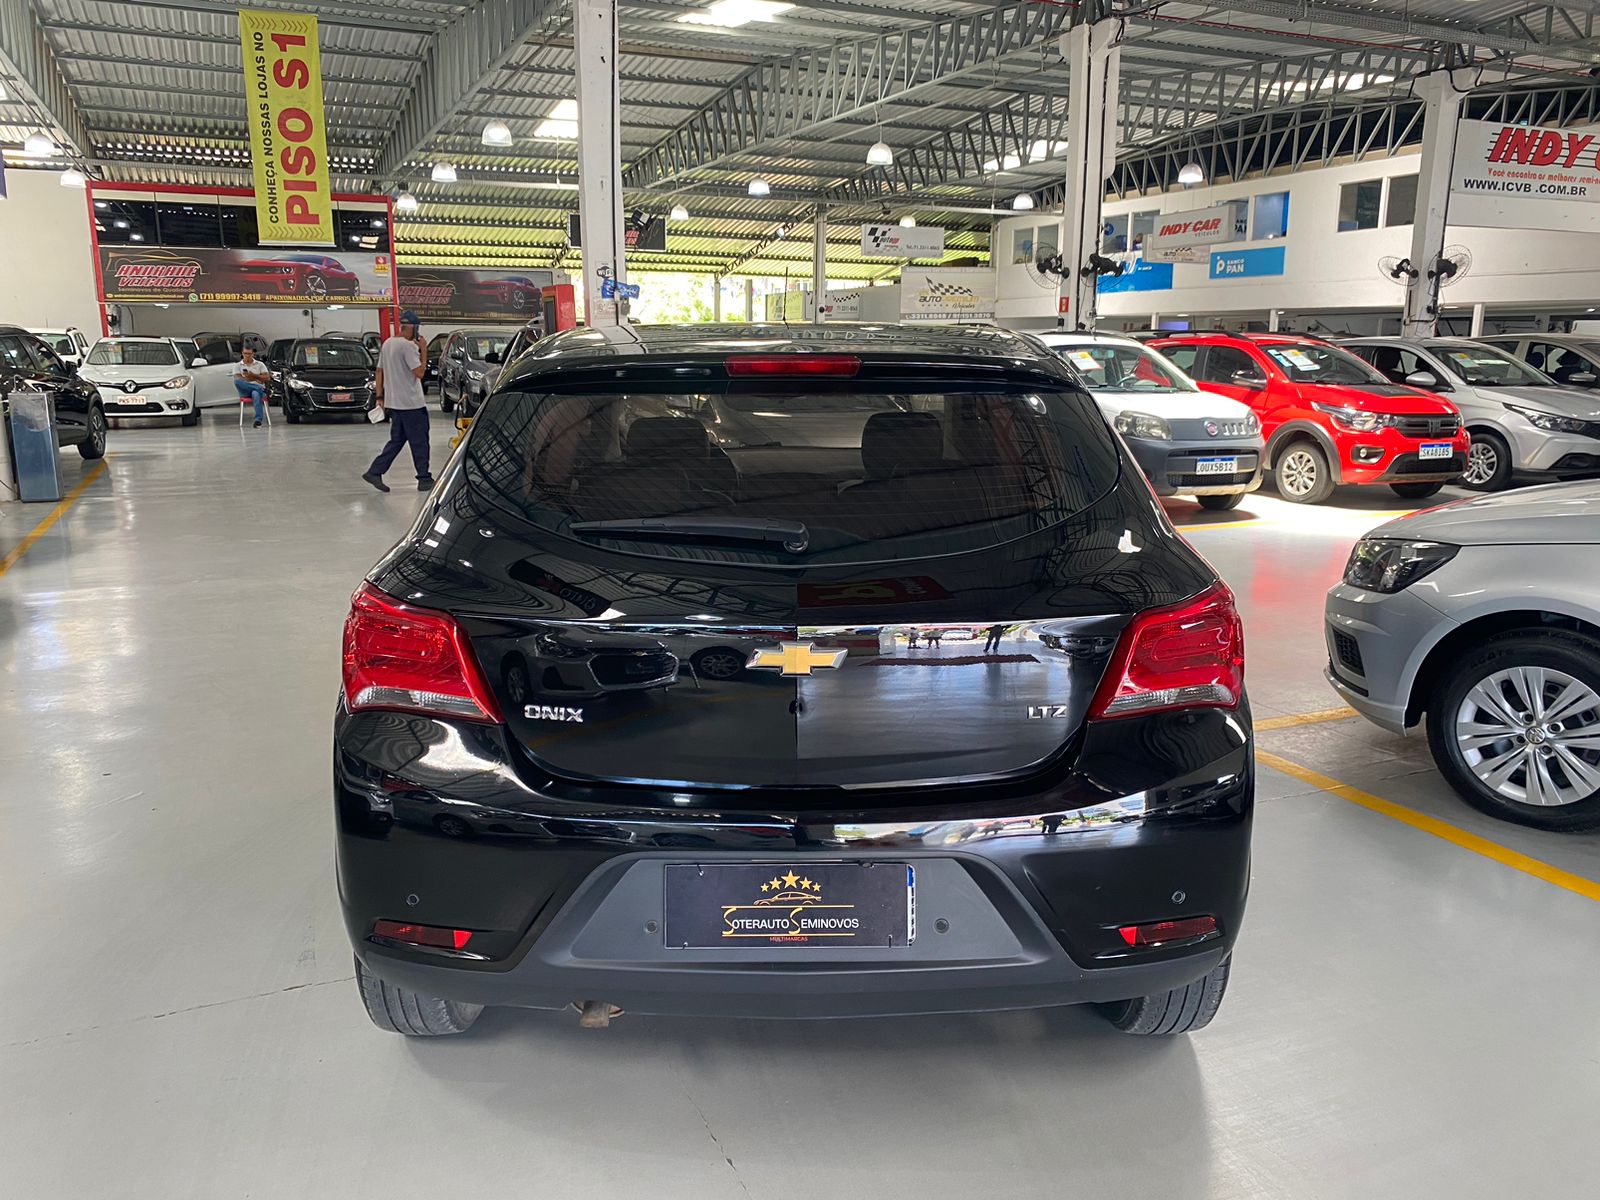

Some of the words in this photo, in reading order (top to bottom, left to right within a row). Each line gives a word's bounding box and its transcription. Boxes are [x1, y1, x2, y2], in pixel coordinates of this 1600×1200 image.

[253, 32, 264, 51] NO
[271, 33, 309, 89] S1
[257, 56, 268, 99] LOJAS
[261, 103, 274, 155] NOSSAS
[1487, 126, 1596, 169] INDY
[278, 108, 319, 224] PISO
[1464, 179, 1532, 193] WWW.ICVB
[1535, 183, 1587, 196] .COM.BR
[1548, 173, 1577, 183] melhores
[268, 160, 278, 223] CONHEÇA
[1159, 222, 1192, 237] INDY
[1192, 218, 1221, 232] CAR
[1226, 263, 1245, 274] PAN
[524, 704, 584, 723] ONIX
[1027, 705, 1068, 719] LTZ
[789, 908, 859, 934] SEMINOVOS
